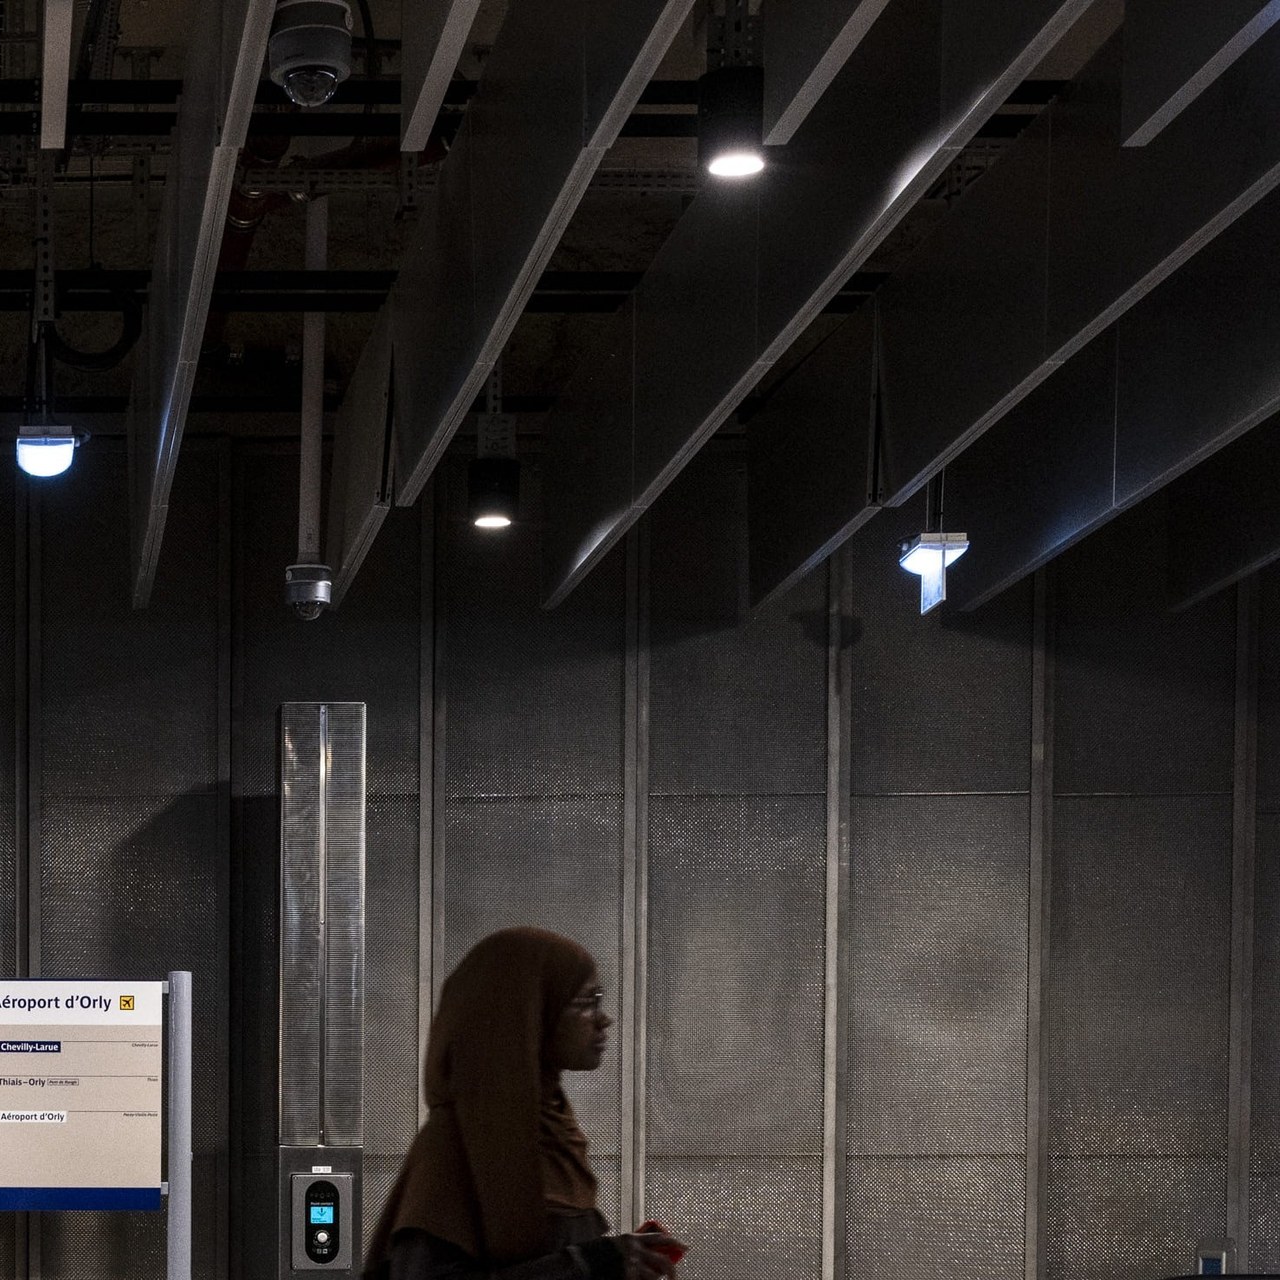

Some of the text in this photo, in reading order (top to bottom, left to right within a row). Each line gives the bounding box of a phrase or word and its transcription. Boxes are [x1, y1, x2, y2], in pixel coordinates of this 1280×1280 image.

[65, 995, 112, 1012] d’Orly
[0, 1042, 59, 1053] Chevilly-Larue
[0, 1111, 65, 1122] Aéroport d’Orly
